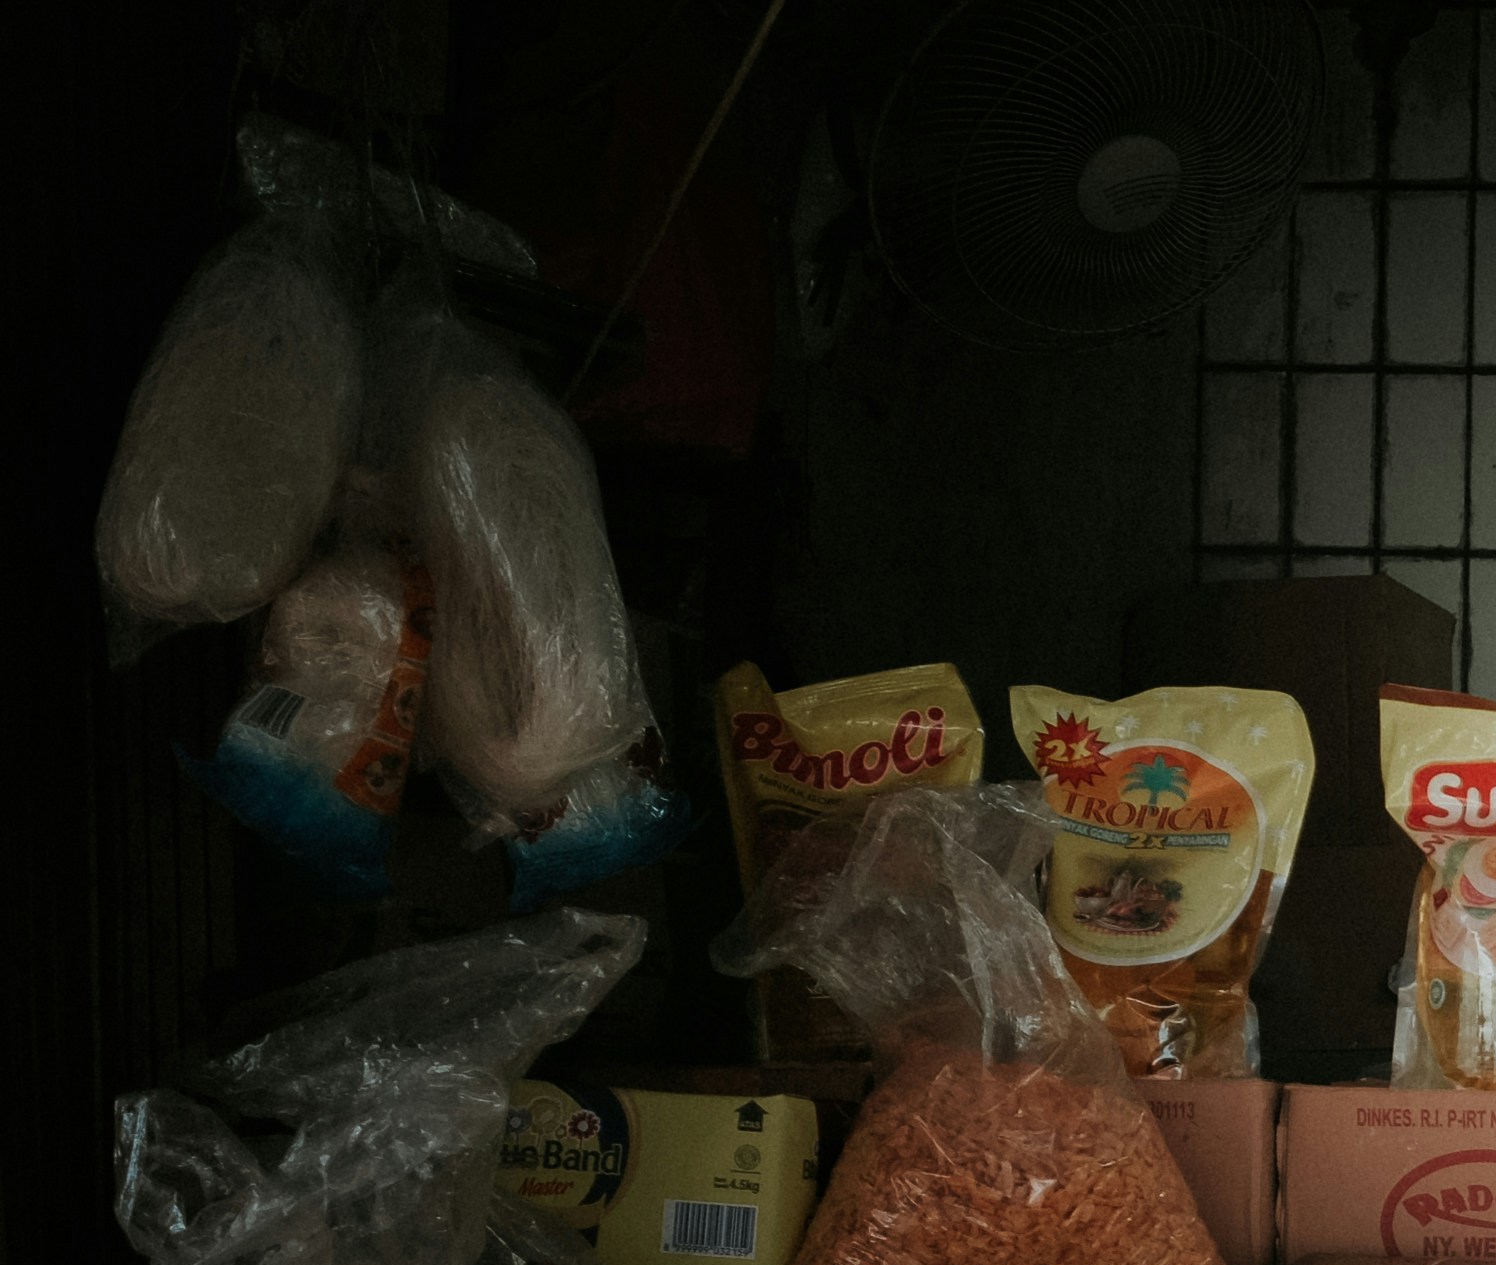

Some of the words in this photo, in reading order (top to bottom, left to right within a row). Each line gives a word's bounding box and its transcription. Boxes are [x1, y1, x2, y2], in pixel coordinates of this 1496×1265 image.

[1044, 733, 1093, 761] 2X
[1062, 790, 1234, 831] TROPICAL
[1356, 1107, 1416, 1127] DINKES.
[1420, 1109, 1443, 1128] R.I.
[1447, 1109, 1486, 1129] P-IRT
[543, 1140, 623, 1176] Band
[518, 1177, 575, 1198] Master
[728, 1179, 760, 1194] 4.5kg
[1423, 1236, 1456, 1257] NY.
